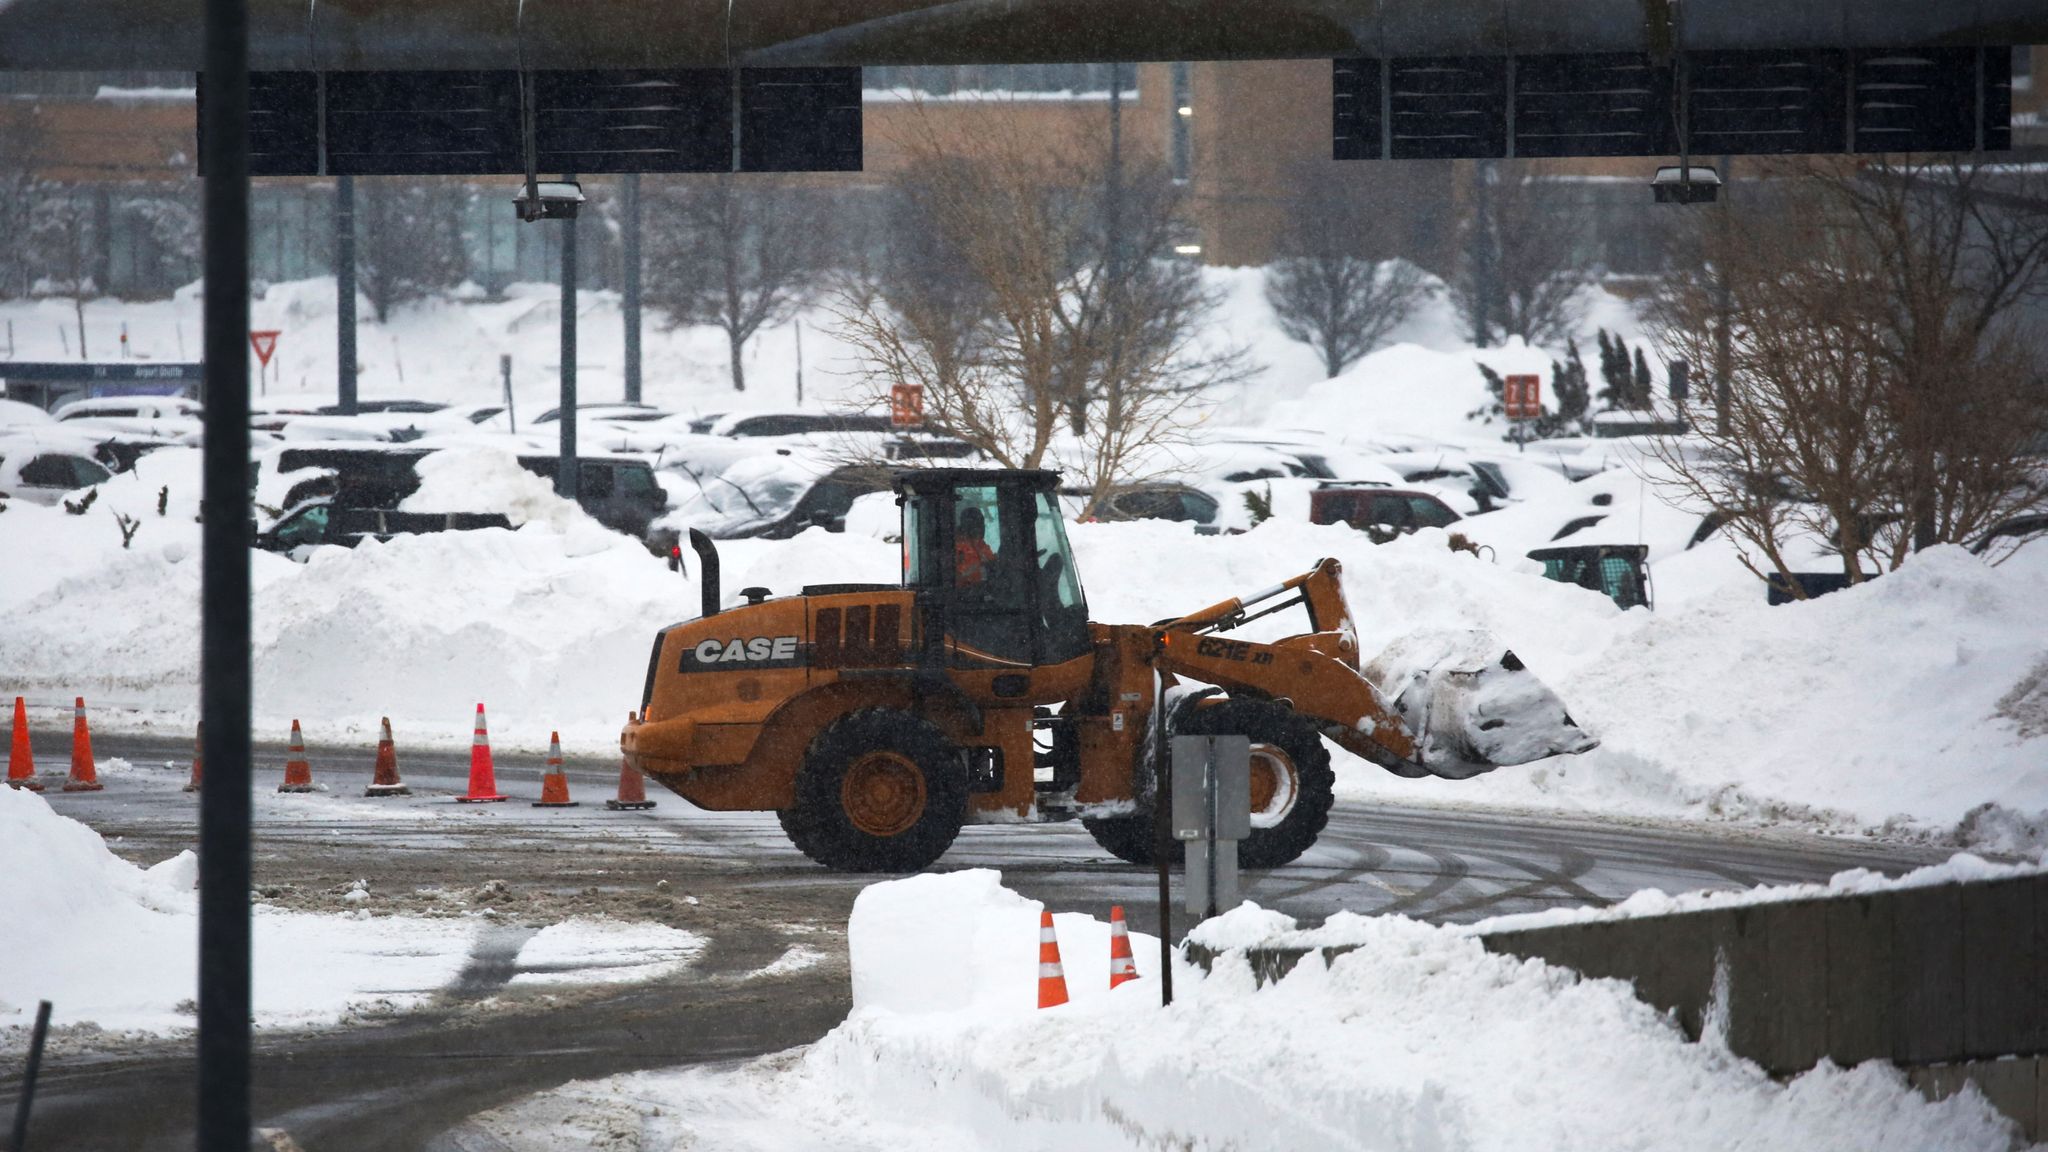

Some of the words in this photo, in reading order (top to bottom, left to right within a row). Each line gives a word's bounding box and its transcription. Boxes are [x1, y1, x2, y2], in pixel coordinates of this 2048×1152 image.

[159, 366, 184, 377] Shuttle
[694, 636, 798, 664] CASE
[1197, 637, 1248, 661] 621E
